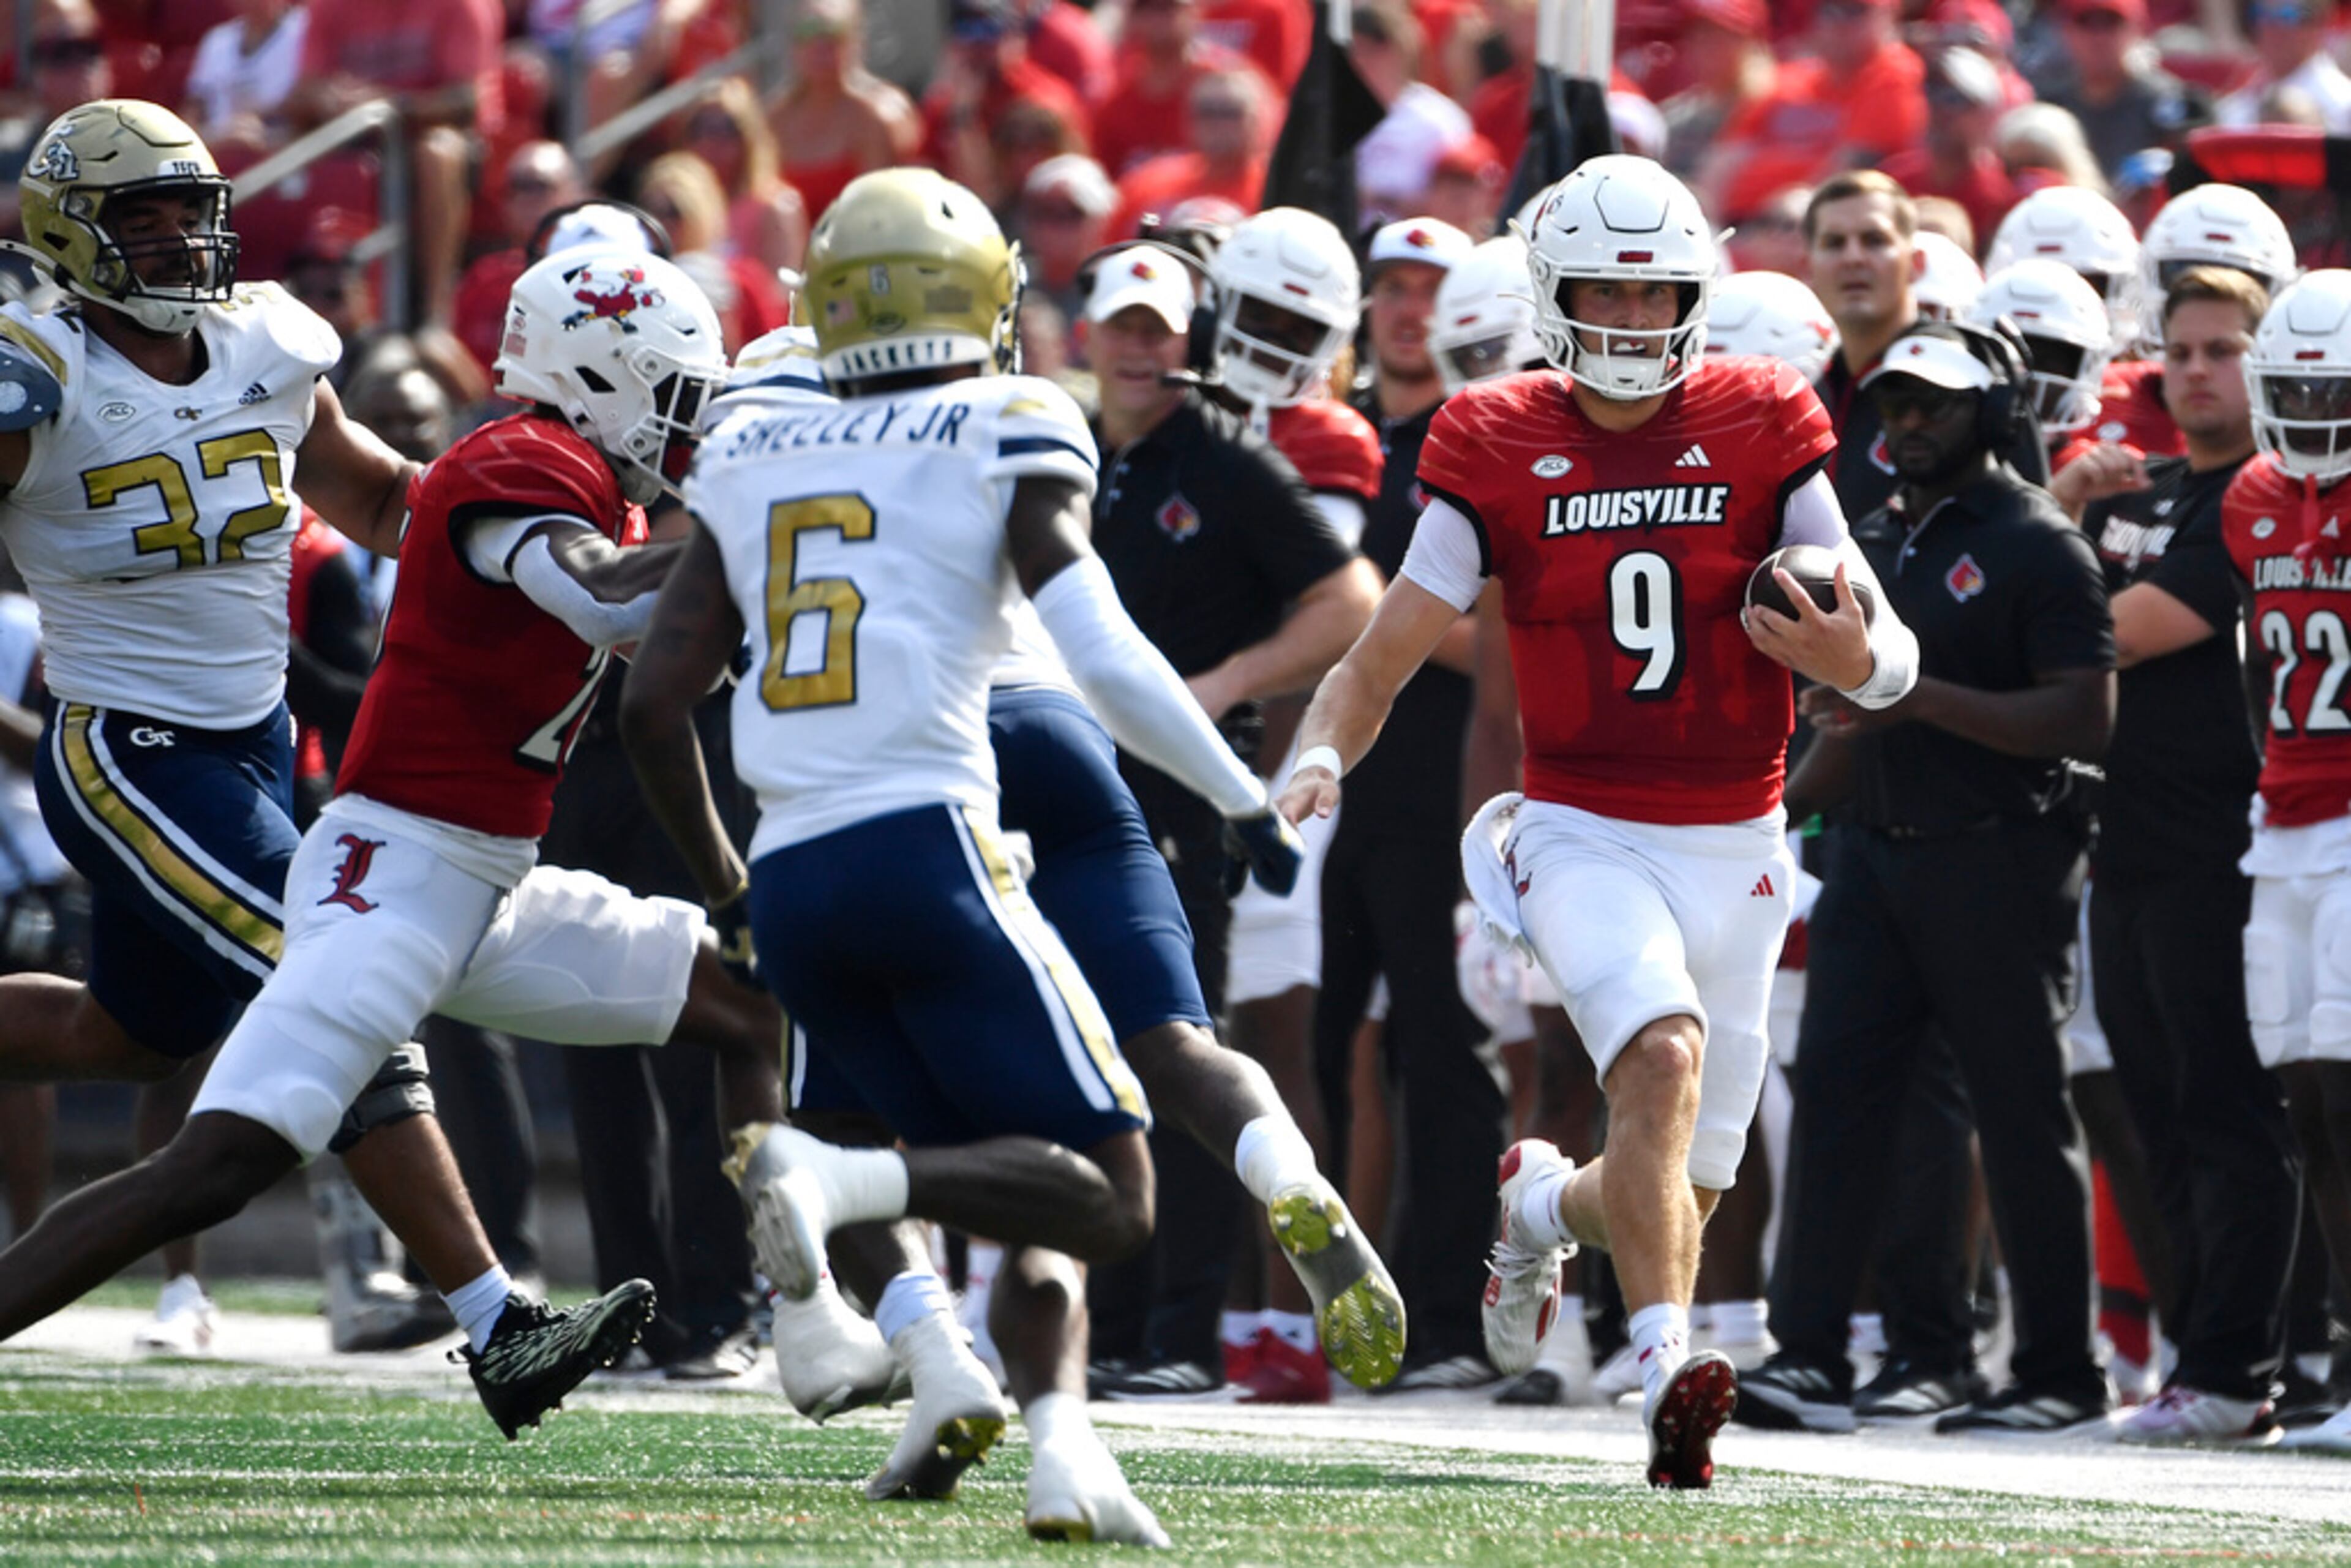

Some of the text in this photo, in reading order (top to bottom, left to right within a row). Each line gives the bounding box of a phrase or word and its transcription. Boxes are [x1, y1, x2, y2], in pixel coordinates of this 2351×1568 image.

[727, 402, 970, 459] SHELLEY JR
[80, 427, 289, 571] 32
[1544, 486, 1728, 536] LOUISVILLE
[759, 492, 877, 715] 6
[1610, 551, 1678, 692] 9
[2260, 610, 2351, 730] 22
